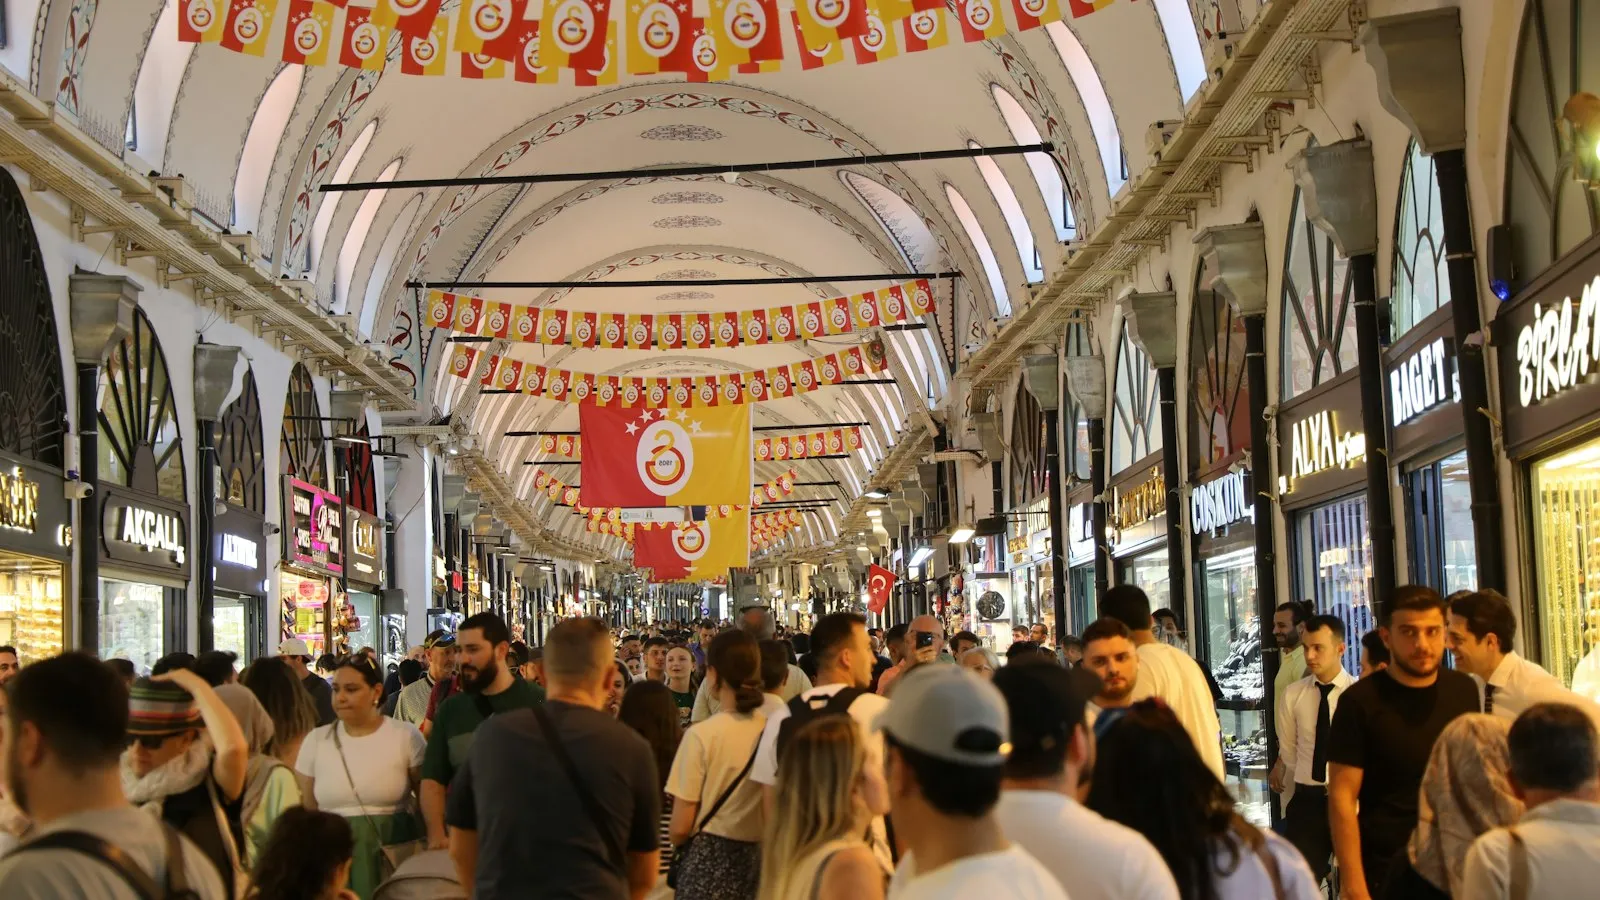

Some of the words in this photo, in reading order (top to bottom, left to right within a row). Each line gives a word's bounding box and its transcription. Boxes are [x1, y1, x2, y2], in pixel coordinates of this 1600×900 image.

[1389, 336, 1447, 427] BAGET
[1291, 410, 1335, 479] ALYA
[123, 505, 178, 552] AKÇALI
[1191, 468, 1245, 539] COŞKUN
